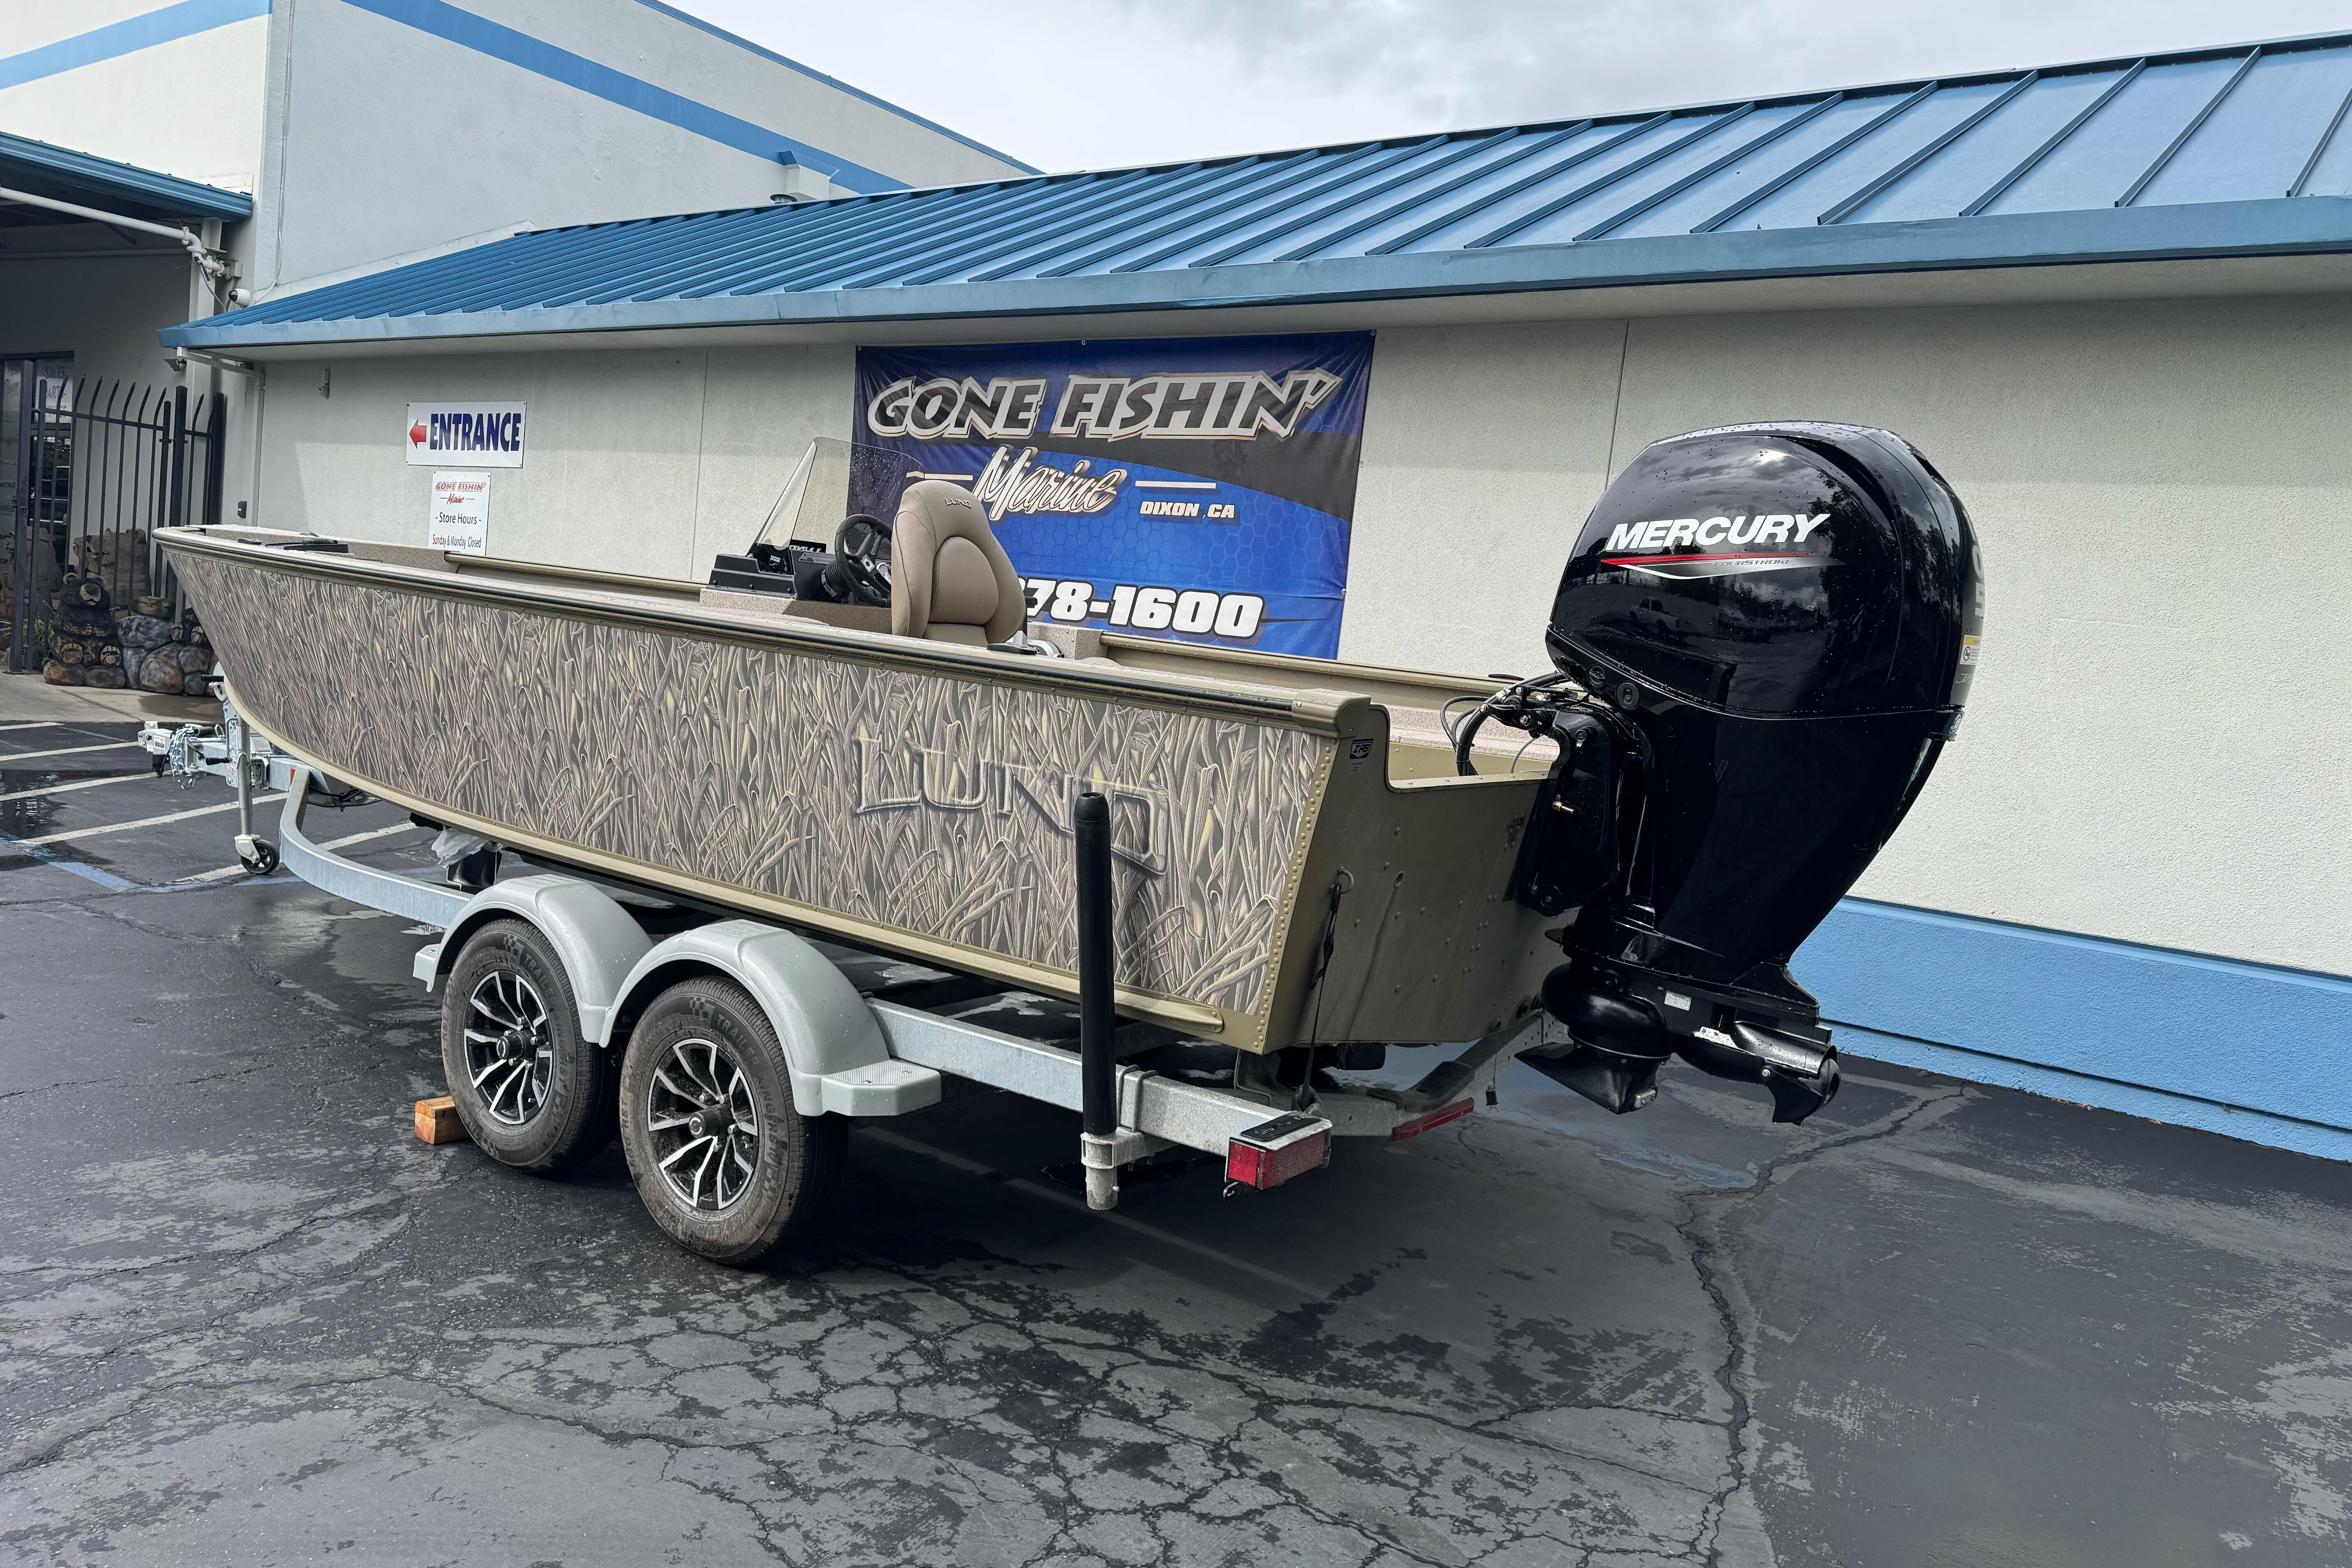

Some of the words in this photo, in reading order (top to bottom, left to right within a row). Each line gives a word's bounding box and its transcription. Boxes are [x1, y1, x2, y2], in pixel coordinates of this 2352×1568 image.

[869, 376, 1046, 439] GONE
[1050, 368, 1342, 441] FISHIN'
[429, 413, 521, 452] ENTRANCE
[436, 482, 456, 491] GONE
[973, 444, 1127, 520] Marine
[439, 512, 456, 523] Store
[457, 513, 477, 524] Hours
[944, 498, 971, 509] LUND
[433, 534, 446, 547] Sunday
[447, 535, 450, 545] &
[450, 536, 466, 549] Monday
[468, 537, 481, 547] Closed
[1606, 514, 1831, 551] MERCURY
[1019, 577, 1264, 639] 78-1600
[1352, 744, 1371, 754] IPS
[856, 736, 1169, 875] LUND
[525, 954, 556, 1006] TRAILER
[717, 1013, 759, 1066] TRAILER
